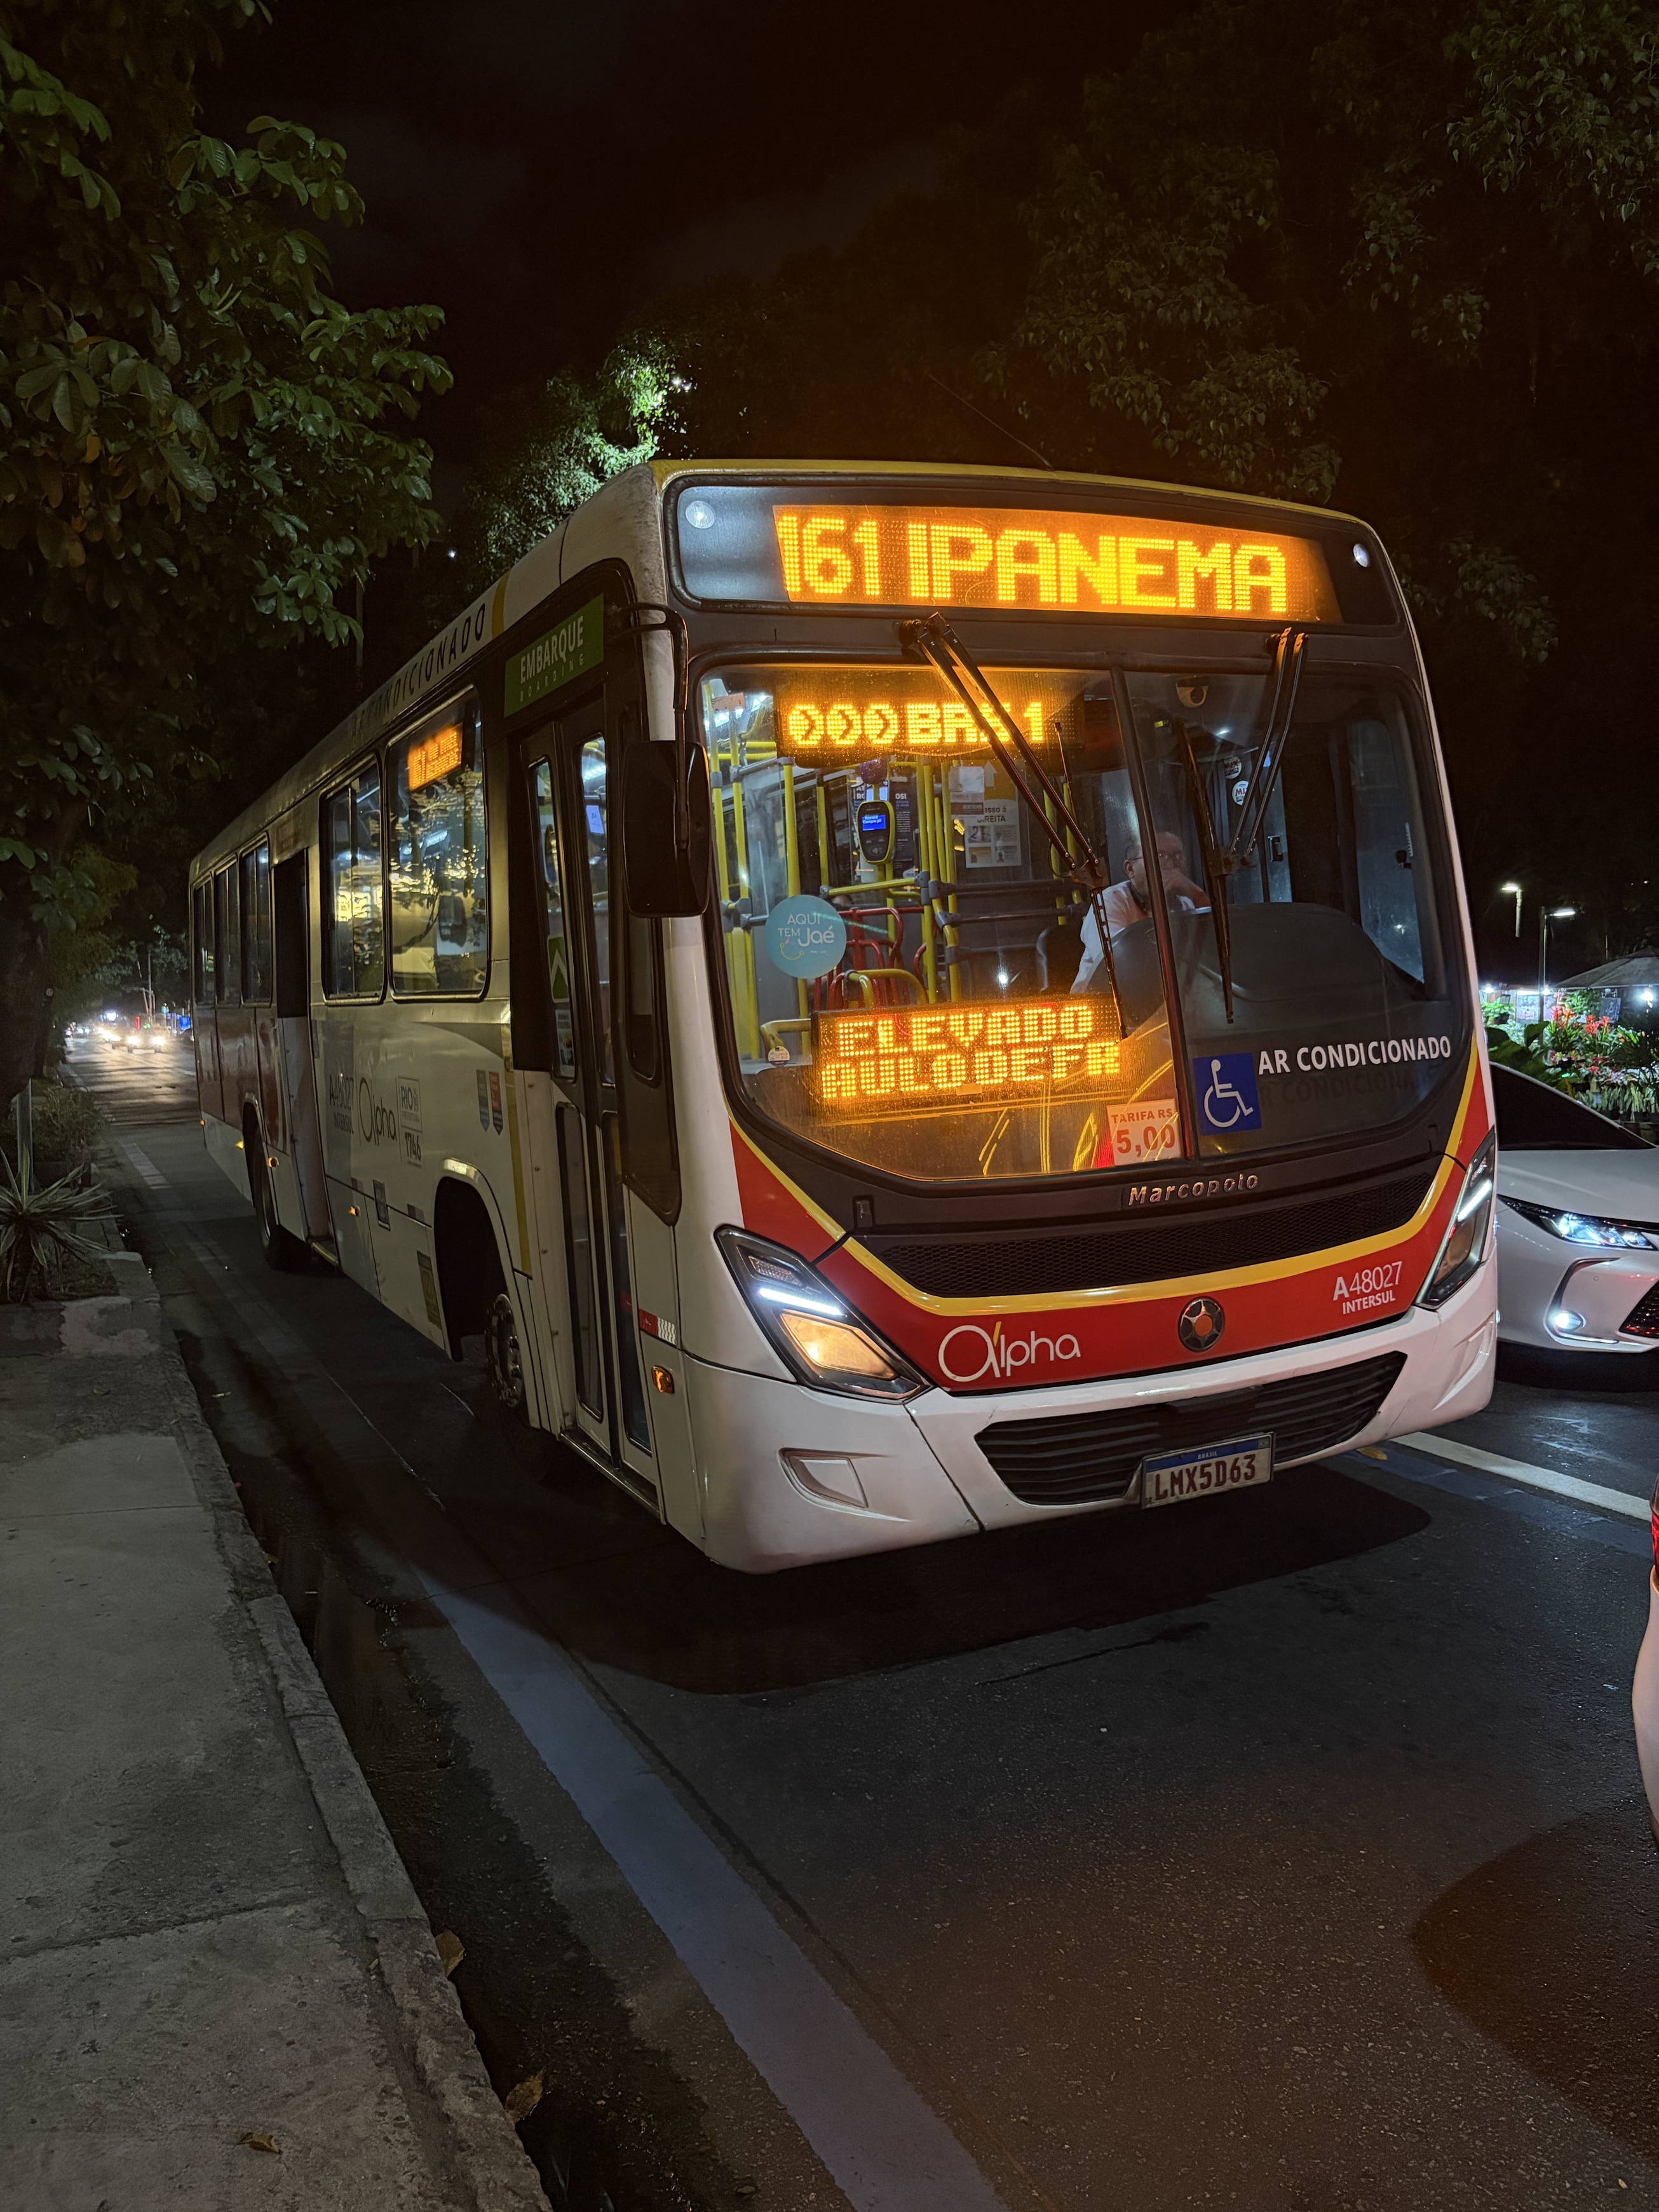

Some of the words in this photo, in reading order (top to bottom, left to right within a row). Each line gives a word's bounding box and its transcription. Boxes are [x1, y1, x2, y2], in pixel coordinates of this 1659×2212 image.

[777, 515, 880, 596] 161
[908, 523, 1287, 613] IPANEMA
[520, 615, 584, 684] EMBARQUE
[520, 653, 584, 702] BOARDING
[1024, 702, 1044, 743] 1
[778, 928, 801, 937] TEM
[797, 925, 835, 947] Jaé
[787, 913, 820, 925] AQUI
[839, 1005, 1092, 1057] ELEVADO
[1257, 1049, 1291, 1076] AR
[1296, 1035, 1452, 1072] CONDICIONADO
[400, 1086, 413, 1111] RIO
[1111, 1110, 1155, 1124] TARIFA
[405, 1132, 422, 1162] 1746
[1116, 1123, 1175, 1158] 5,00
[1127, 1173, 1259, 1207] Marcopolo
[1332, 1260, 1403, 1301] A48027
[1342, 1289, 1396, 1315] INTERSUL
[1197, 1450, 1218, 1460] BRASIL
[1155, 1453, 1256, 1502] LMX5D63
